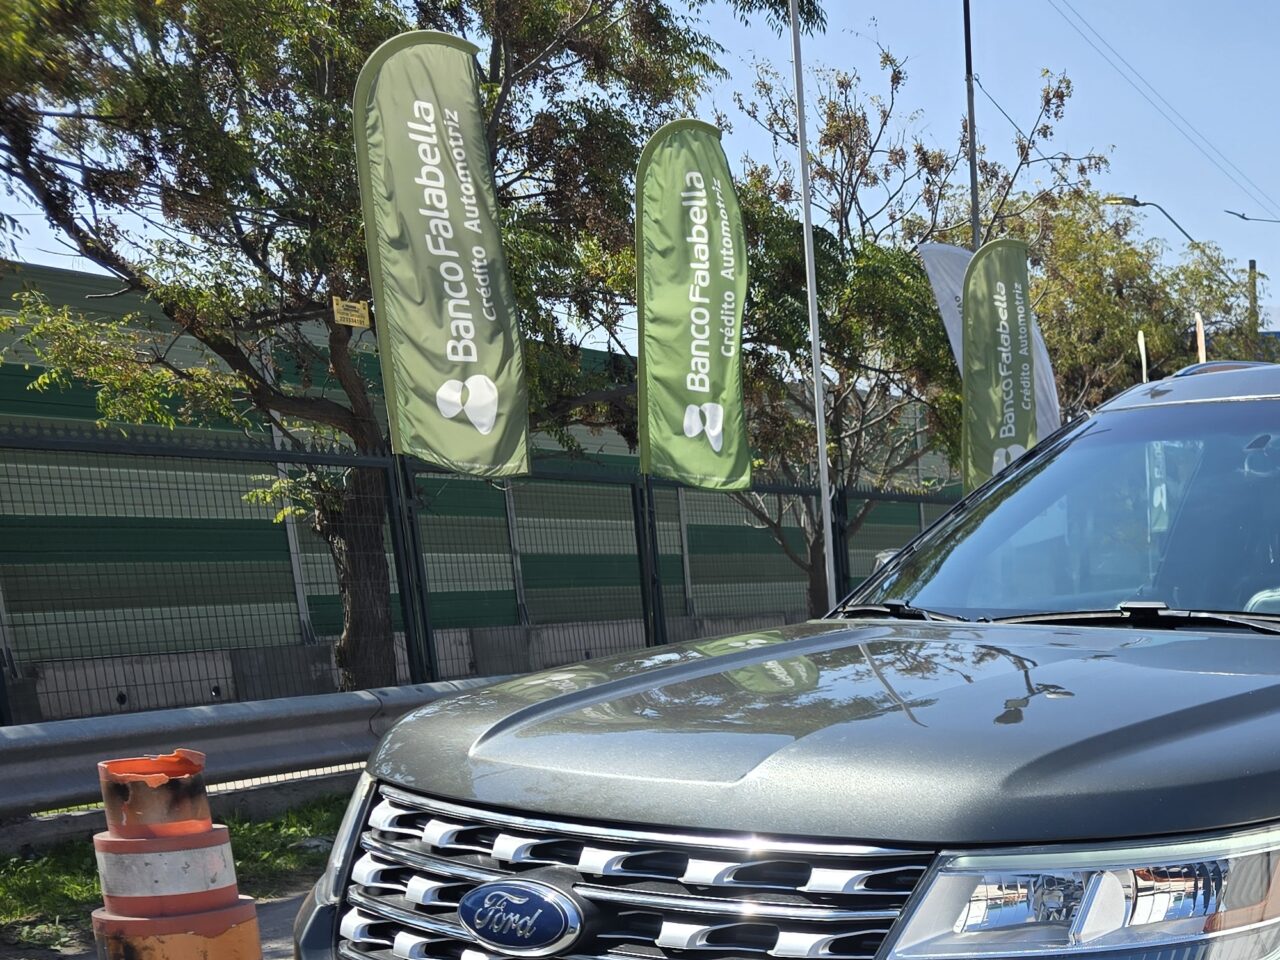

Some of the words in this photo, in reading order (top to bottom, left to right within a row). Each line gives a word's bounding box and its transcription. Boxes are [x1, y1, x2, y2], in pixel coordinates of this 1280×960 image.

[443, 108, 483, 234] Automotriz
[712, 177, 735, 281] Automotriz
[720, 290, 736, 358] Crédito
[1013, 282, 1029, 356] Automotriz
[1020, 363, 1032, 411] Crédito
[473, 890, 544, 939] Ford
